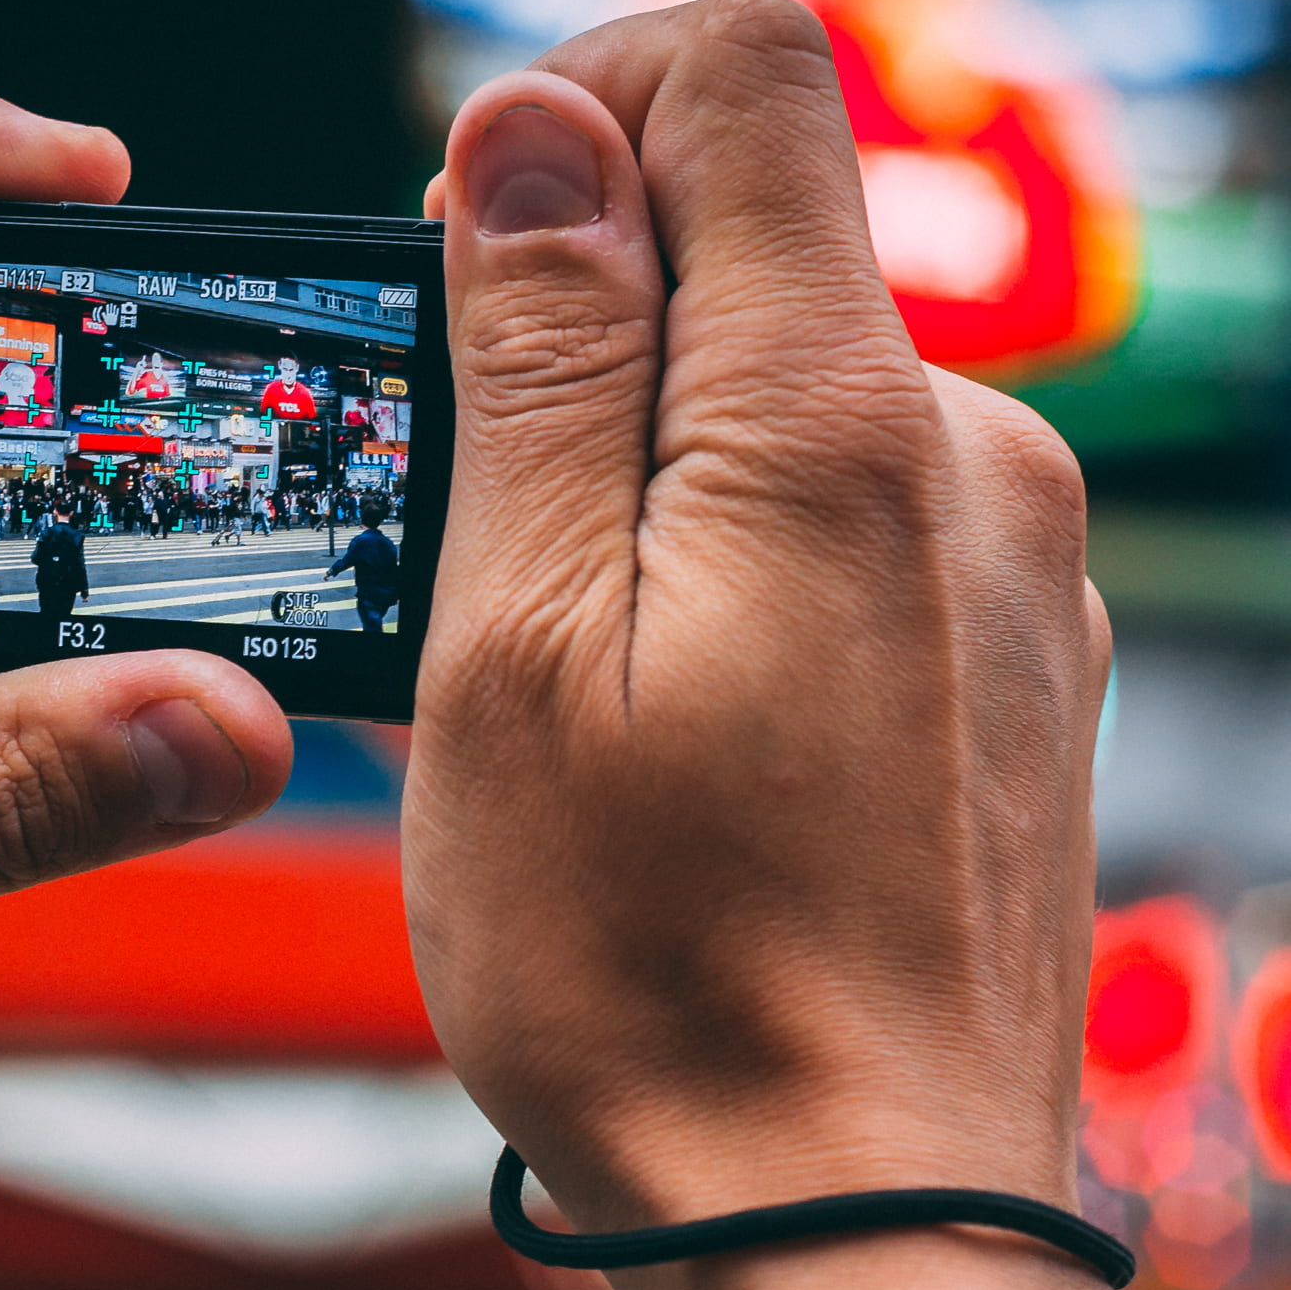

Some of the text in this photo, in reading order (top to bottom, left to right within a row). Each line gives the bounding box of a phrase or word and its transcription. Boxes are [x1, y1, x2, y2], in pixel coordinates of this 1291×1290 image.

[10, 268, 45, 290] 1417
[65, 273, 90, 290] 3:2
[137, 275, 178, 297] RAW
[196, 378, 253, 392] BORN A LEGEND
[278, 402, 301, 413] TCL
[285, 592, 320, 609] STEP
[284, 609, 328, 627] ZOOM
[58, 621, 106, 650] F3.2
